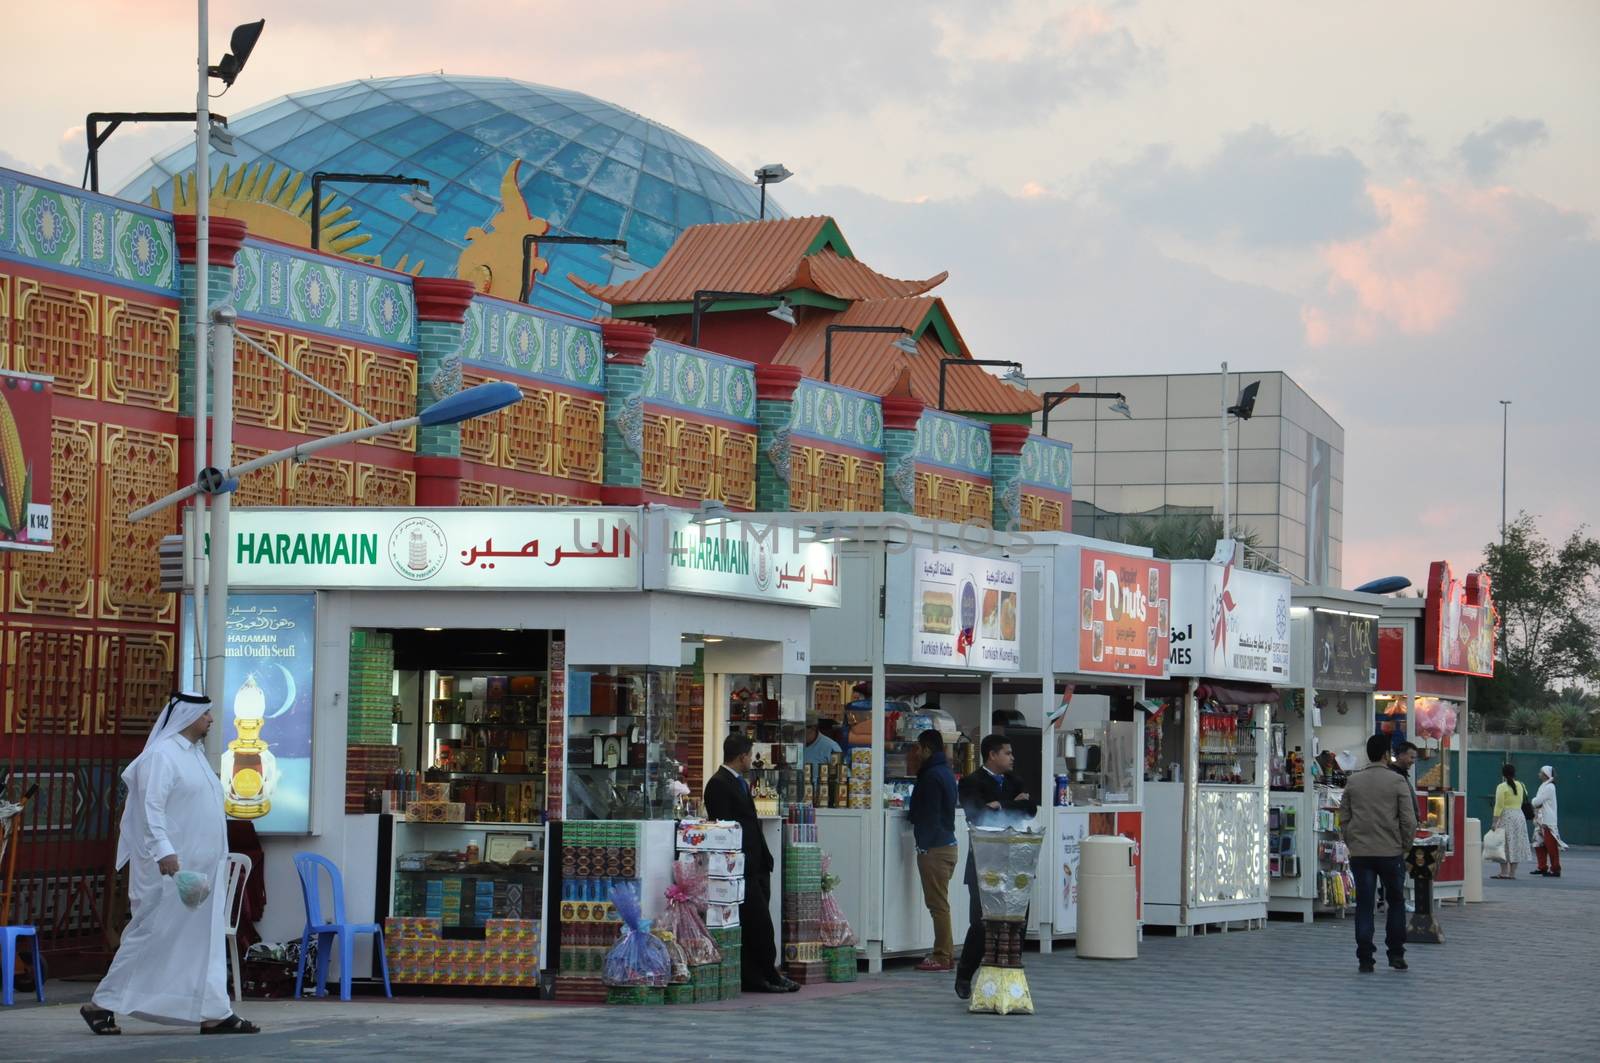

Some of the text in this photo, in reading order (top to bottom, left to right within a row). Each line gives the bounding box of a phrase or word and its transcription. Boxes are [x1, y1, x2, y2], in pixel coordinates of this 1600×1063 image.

[30, 514, 49, 530] K 142
[236, 532, 378, 565] HARAMAIN
[460, 527, 631, 569] الحرمين
[671, 530, 750, 576] AL HARAMAIN
[775, 554, 839, 592] الحرمين
[227, 634, 277, 643] HARAMAIN
[244, 645, 270, 657] Oudh
[921, 640, 939, 656] Turkish
[982, 645, 999, 660] Turkish
